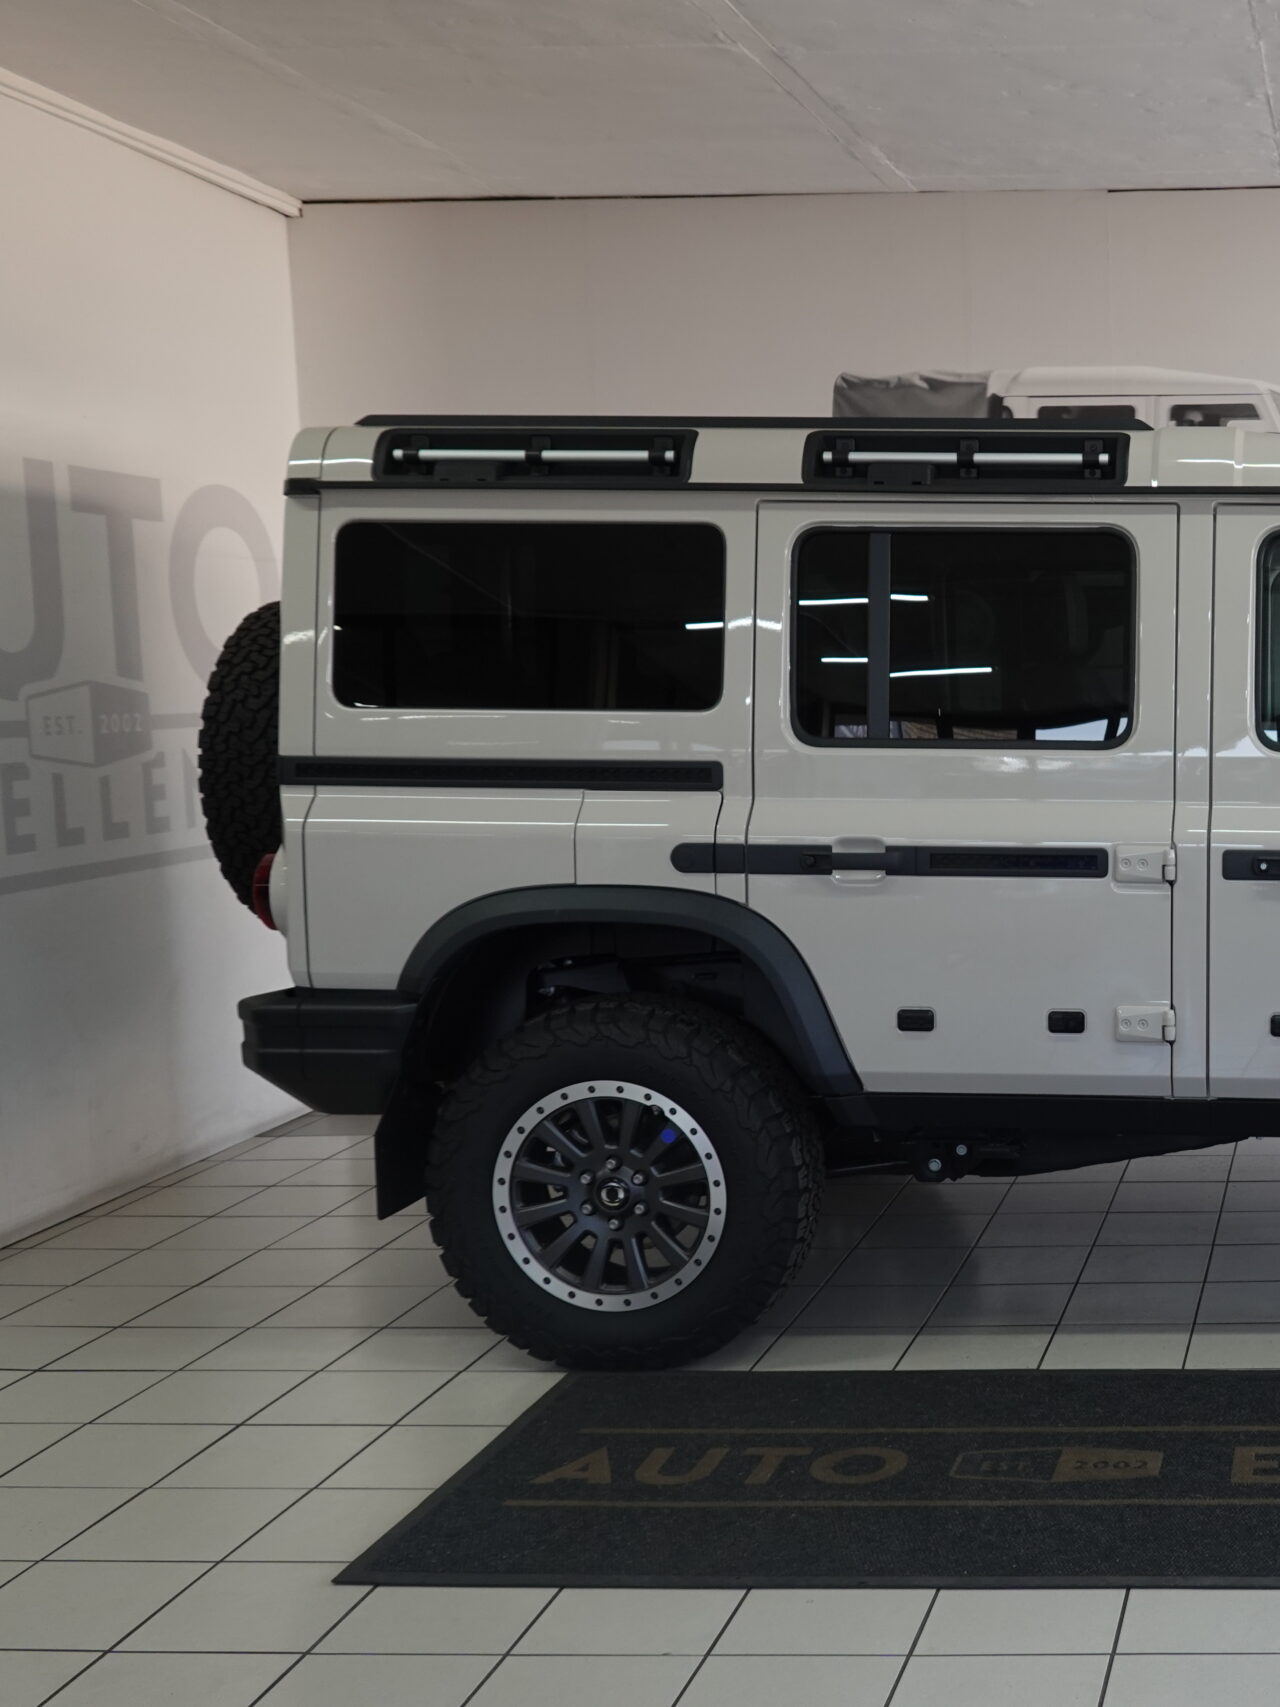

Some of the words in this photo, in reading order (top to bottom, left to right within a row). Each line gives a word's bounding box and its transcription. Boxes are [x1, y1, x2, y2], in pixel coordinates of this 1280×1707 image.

[43, 714, 84, 736] EST.
[100, 712, 144, 735] 2002
[529, 1446, 909, 1485] AUTO
[1073, 1459, 1149, 1471] 2002
